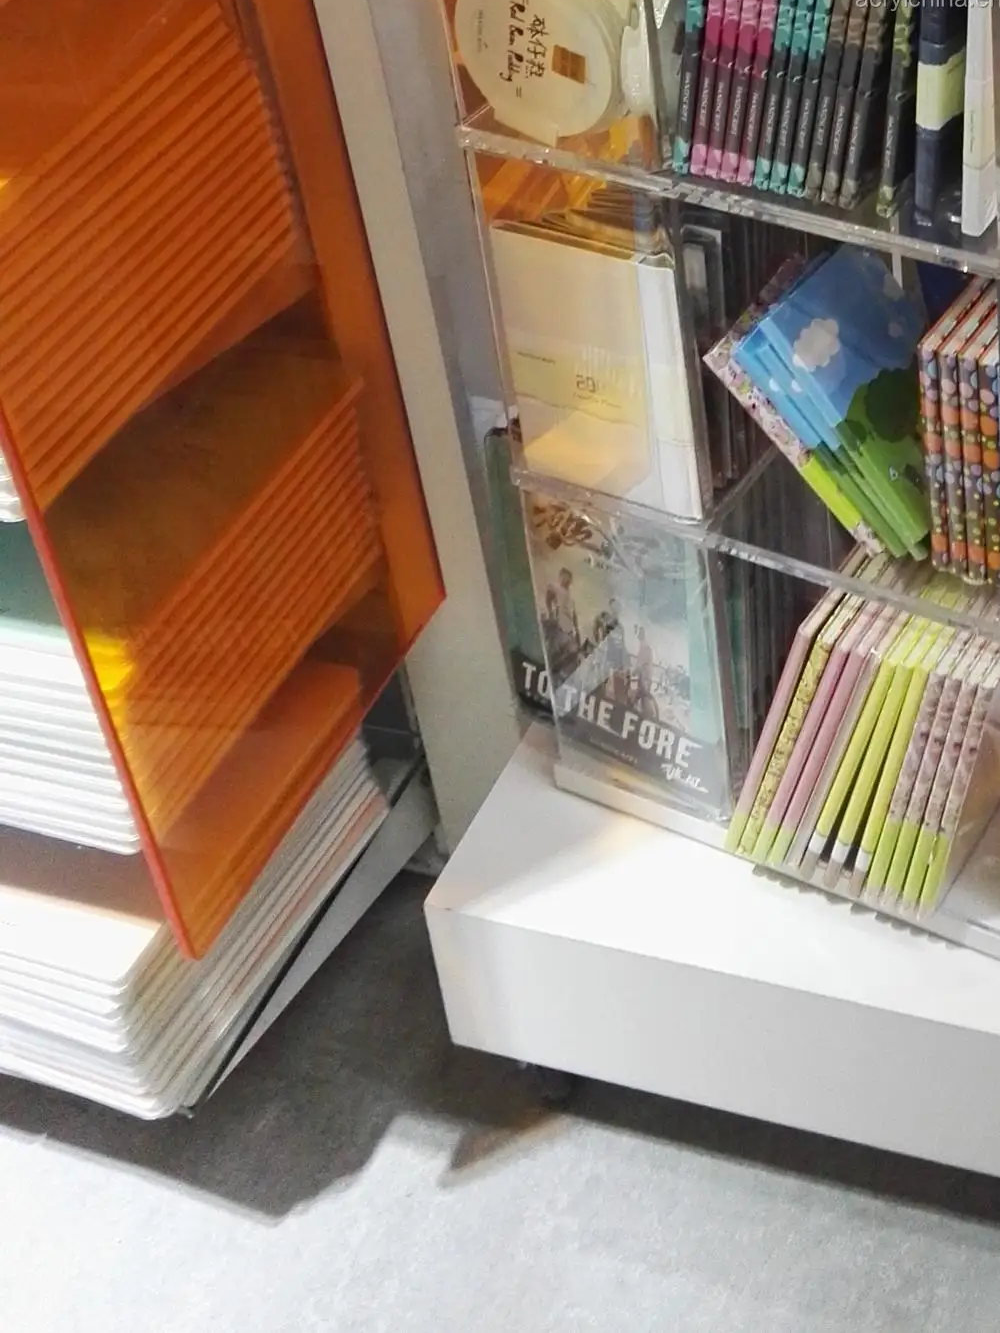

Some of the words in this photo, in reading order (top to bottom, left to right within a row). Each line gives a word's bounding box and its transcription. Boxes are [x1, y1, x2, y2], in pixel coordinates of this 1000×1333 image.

[522, 662, 551, 695] TO
[564, 685, 617, 736] THE
[621, 710, 703, 768] FORE
